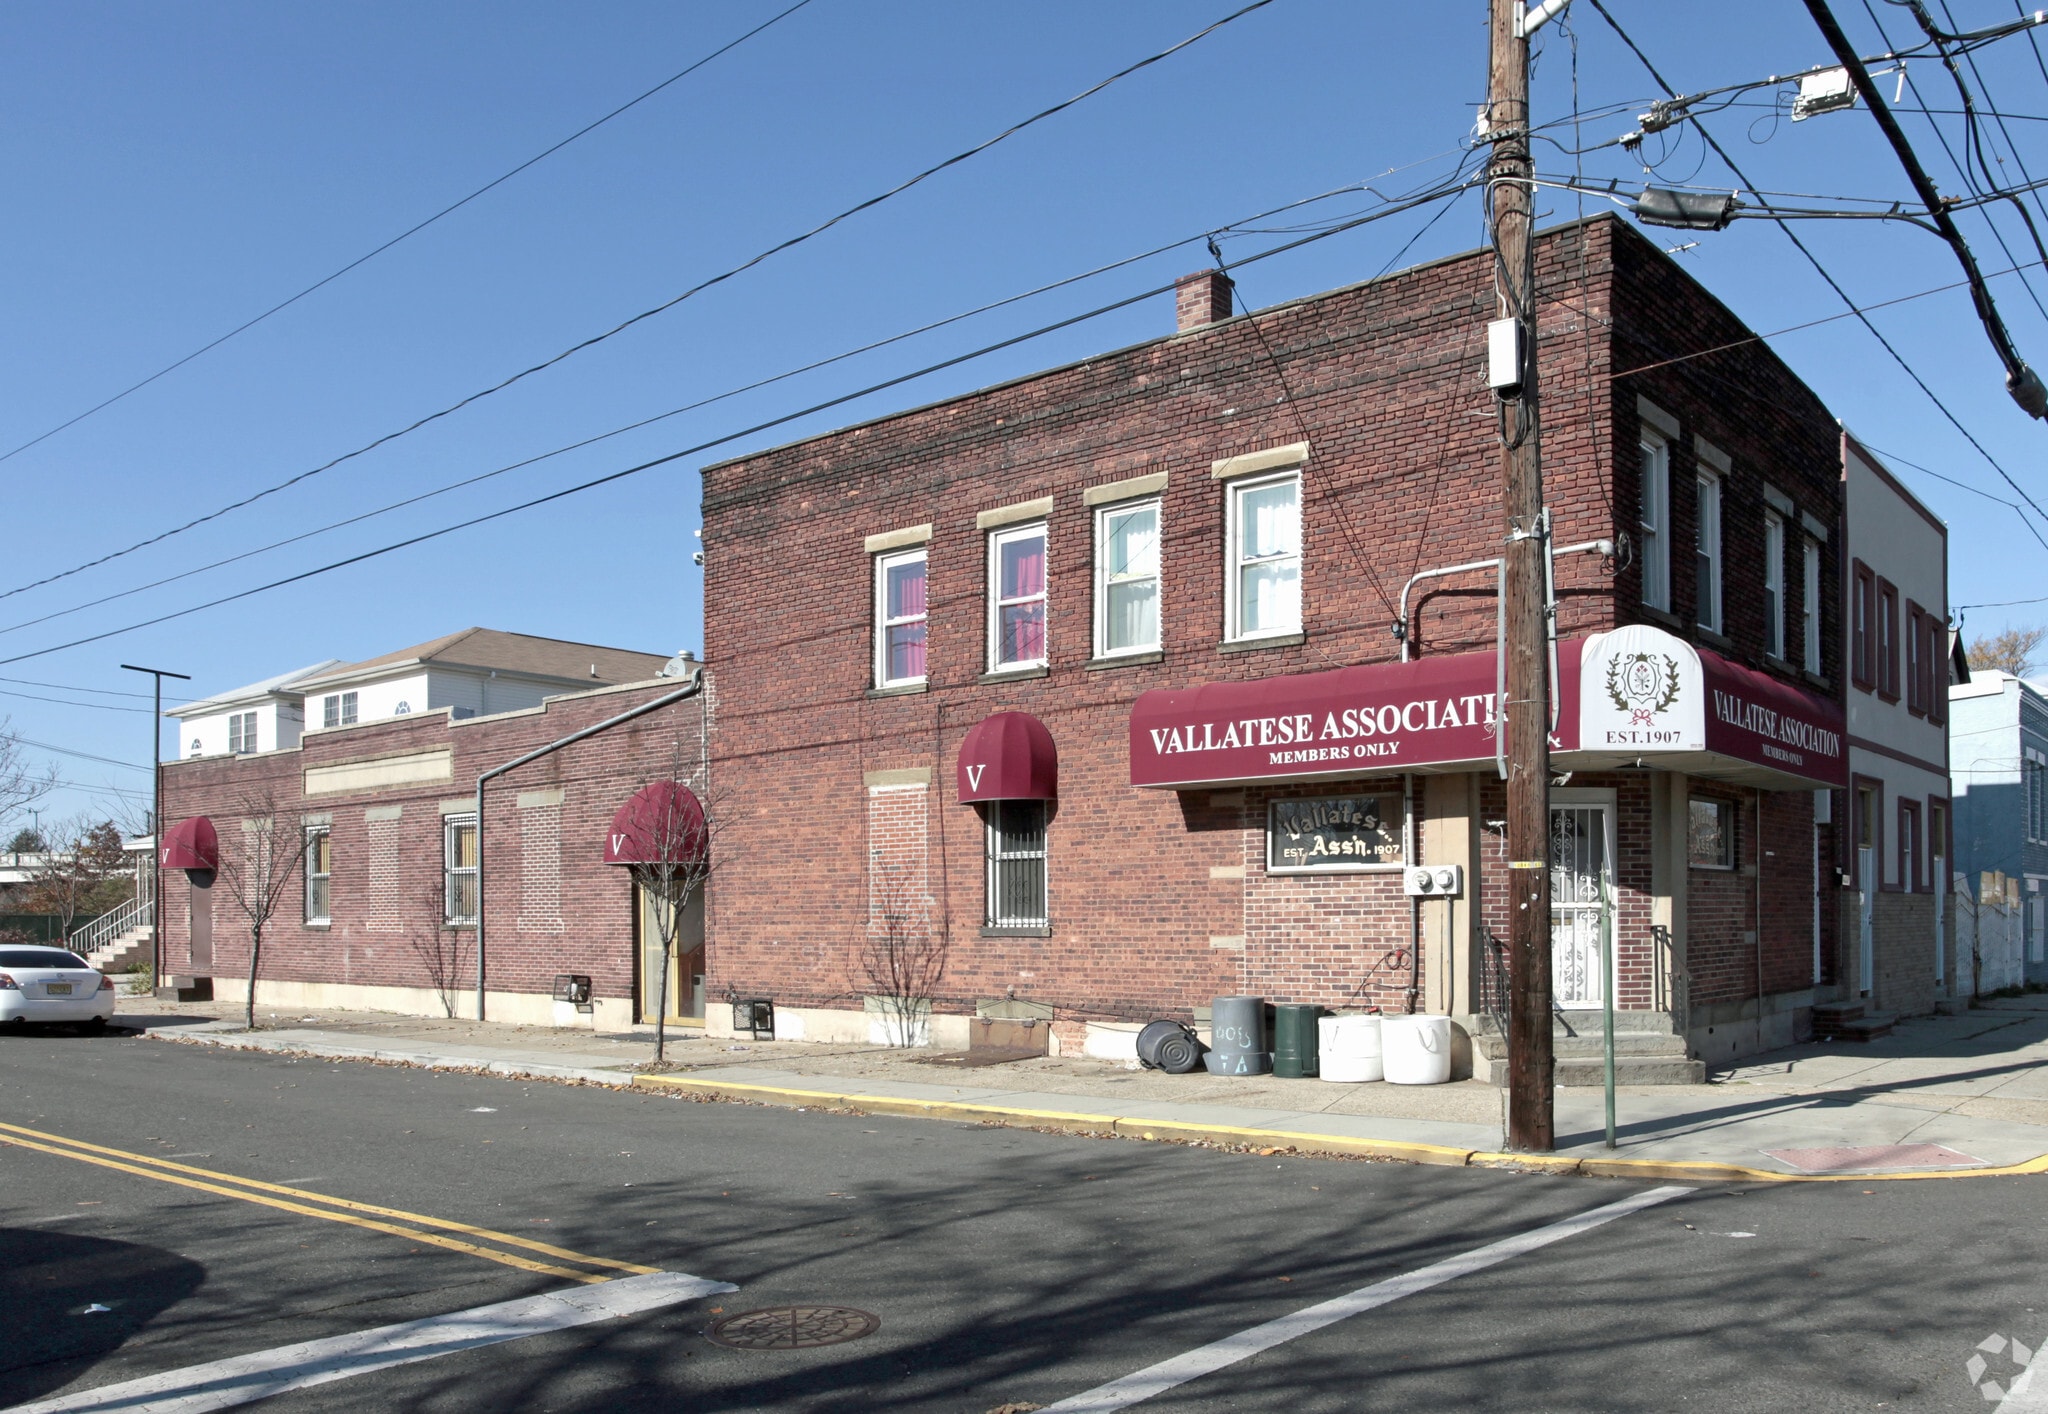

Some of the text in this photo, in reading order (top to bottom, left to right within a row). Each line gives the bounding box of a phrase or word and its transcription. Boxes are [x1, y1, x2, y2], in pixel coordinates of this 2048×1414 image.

[1150, 692, 1509, 755] VALLATESE ASSOCIATI
[1713, 689, 1840, 758] VALLATESE ASSOCIATION
[1269, 741, 1400, 765] MEMBERS ONLY
[1762, 743, 1803, 766] MEMBERS ONLY
[966, 764, 986, 792] V
[162, 848, 170, 864] V
[612, 834, 626, 856] V
[1283, 848, 1305, 858] EST.
[1374, 844, 1400, 856] 1907
